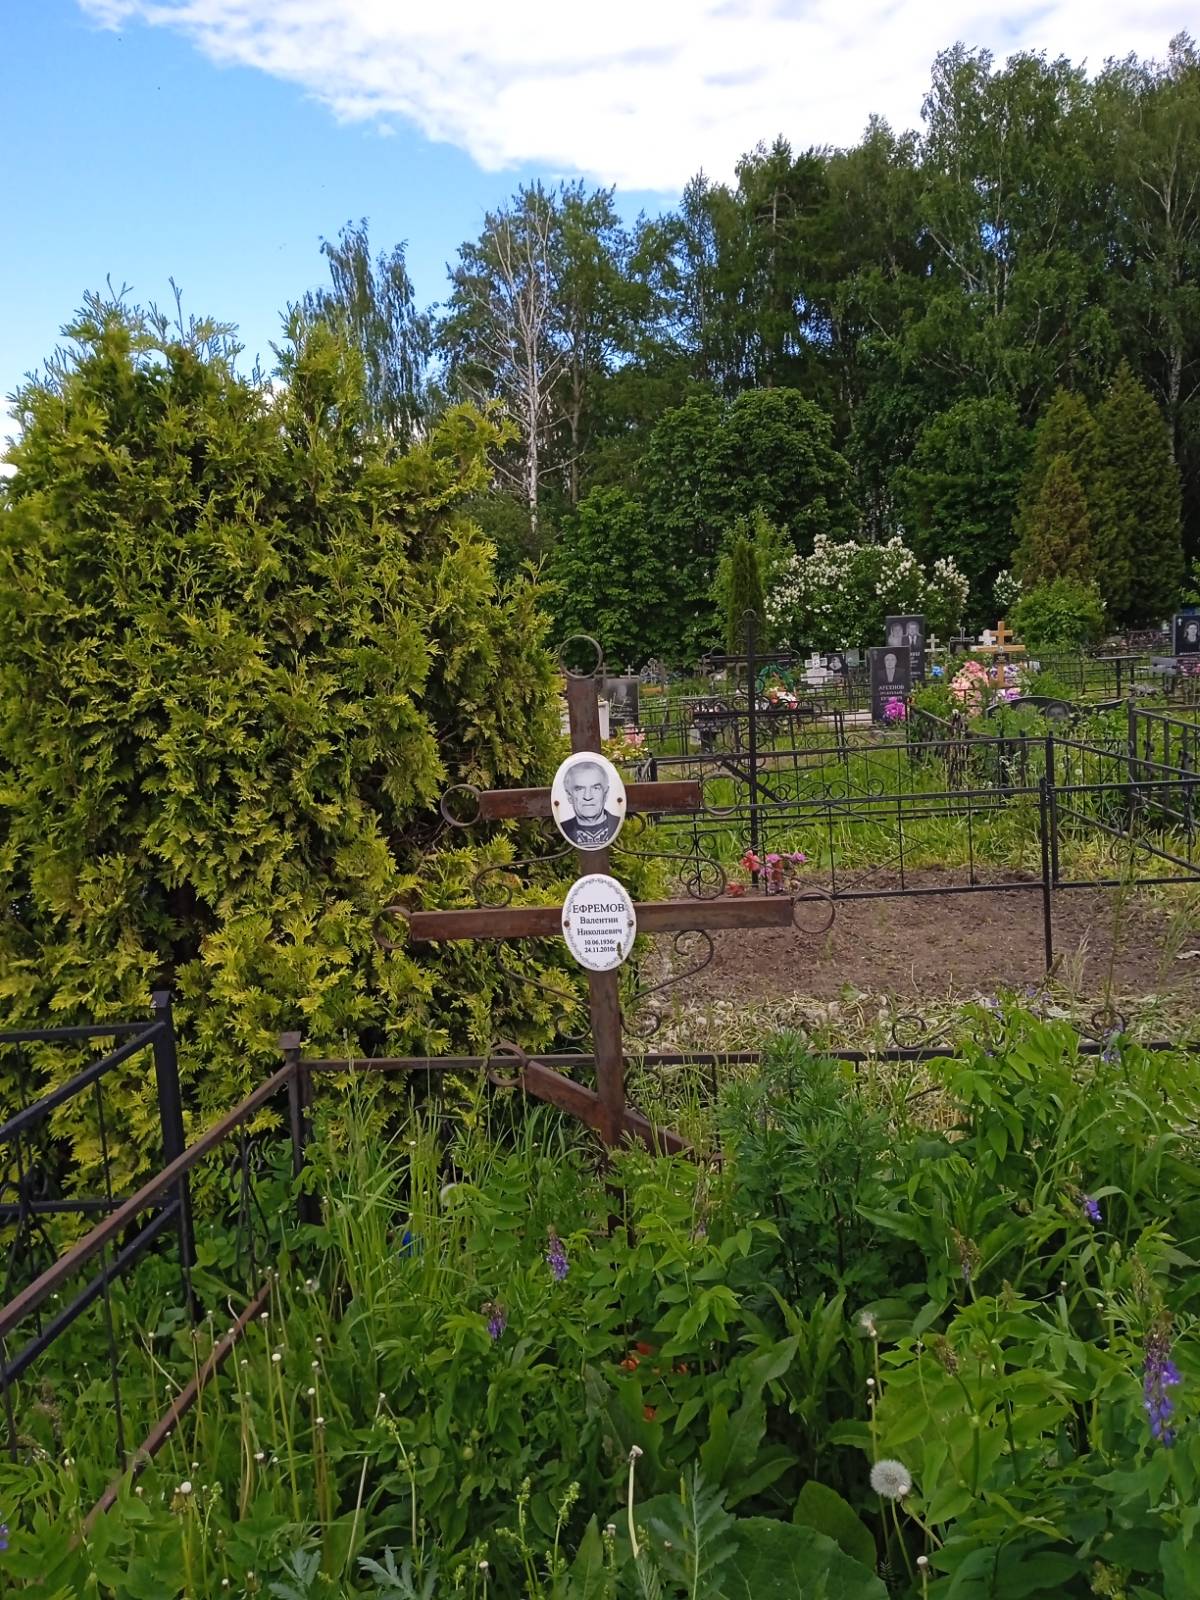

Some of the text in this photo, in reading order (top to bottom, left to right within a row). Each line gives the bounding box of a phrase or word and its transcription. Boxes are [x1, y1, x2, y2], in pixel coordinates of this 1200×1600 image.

[572, 904, 625, 914] ЕФРЕМОВ
[580, 916, 618, 924] Валентин
[577, 928, 622, 936] Николаевич
